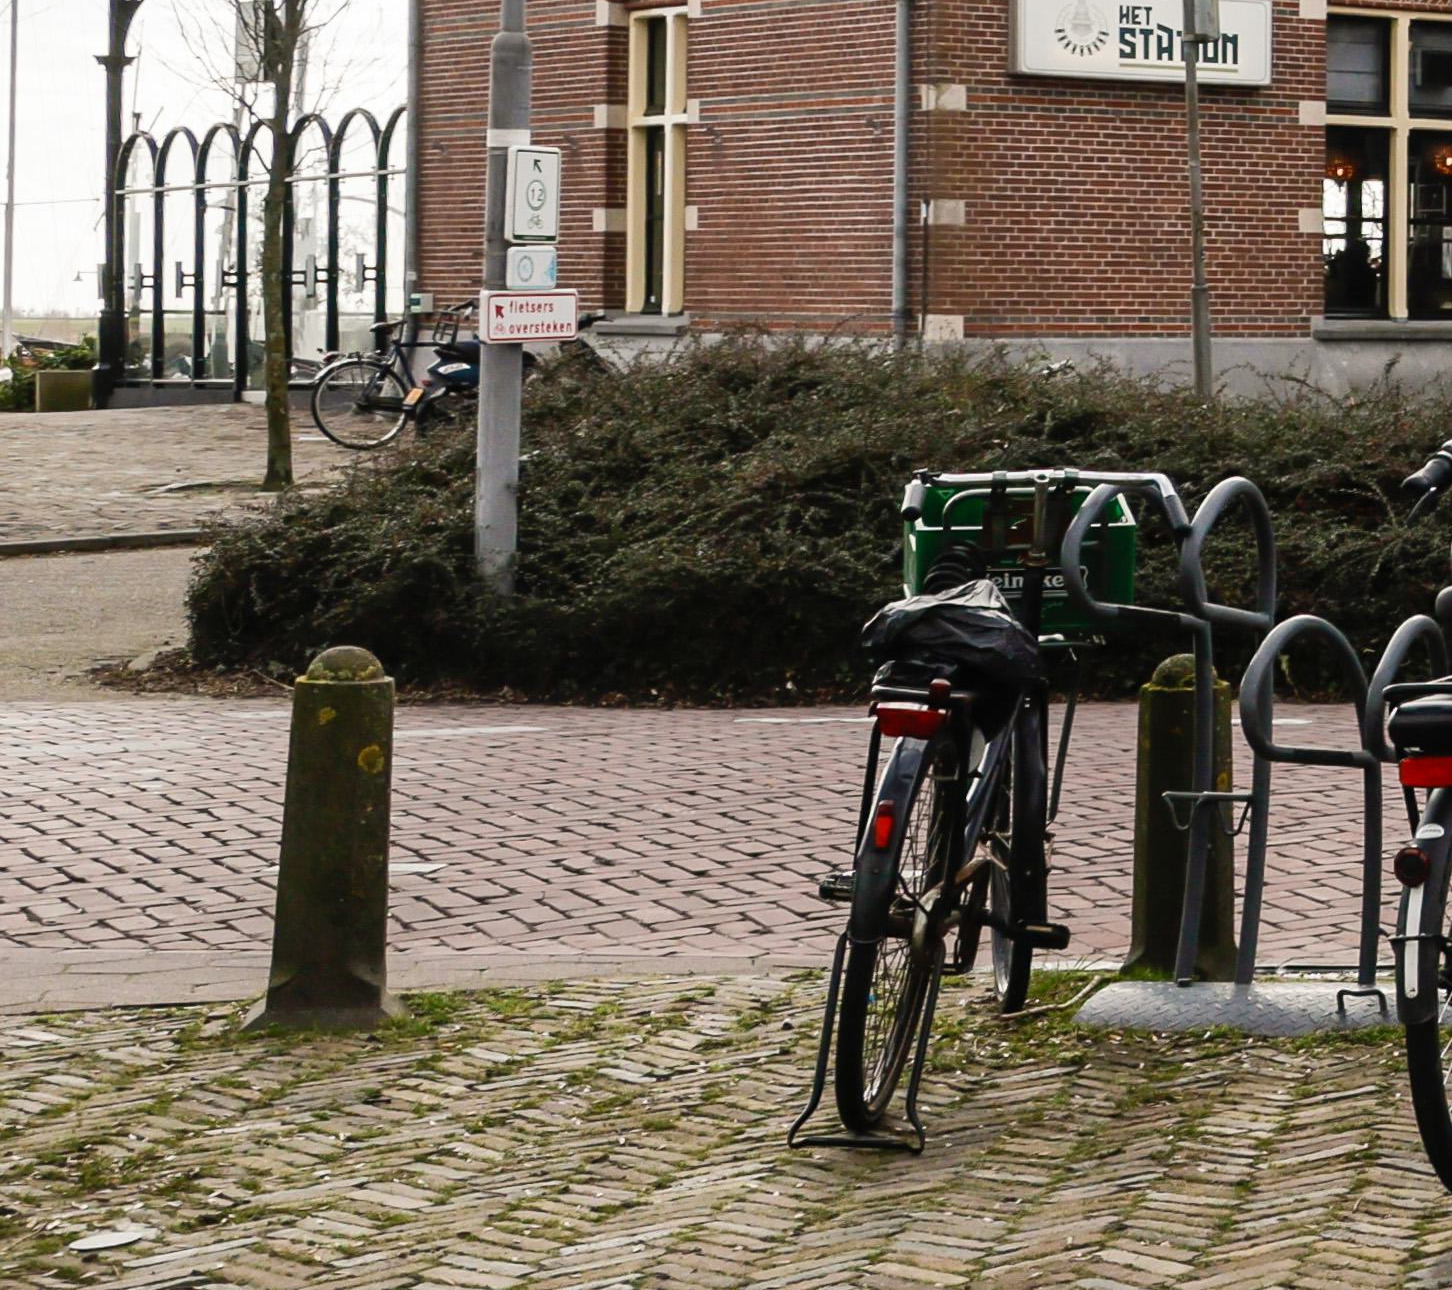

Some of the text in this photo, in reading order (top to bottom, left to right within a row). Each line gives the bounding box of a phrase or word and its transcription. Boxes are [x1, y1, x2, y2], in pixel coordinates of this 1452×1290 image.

[1119, 5, 1152, 26] HET
[530, 188, 545, 202] 12
[509, 300, 554, 315] fietsers
[509, 321, 573, 335] oversteken
